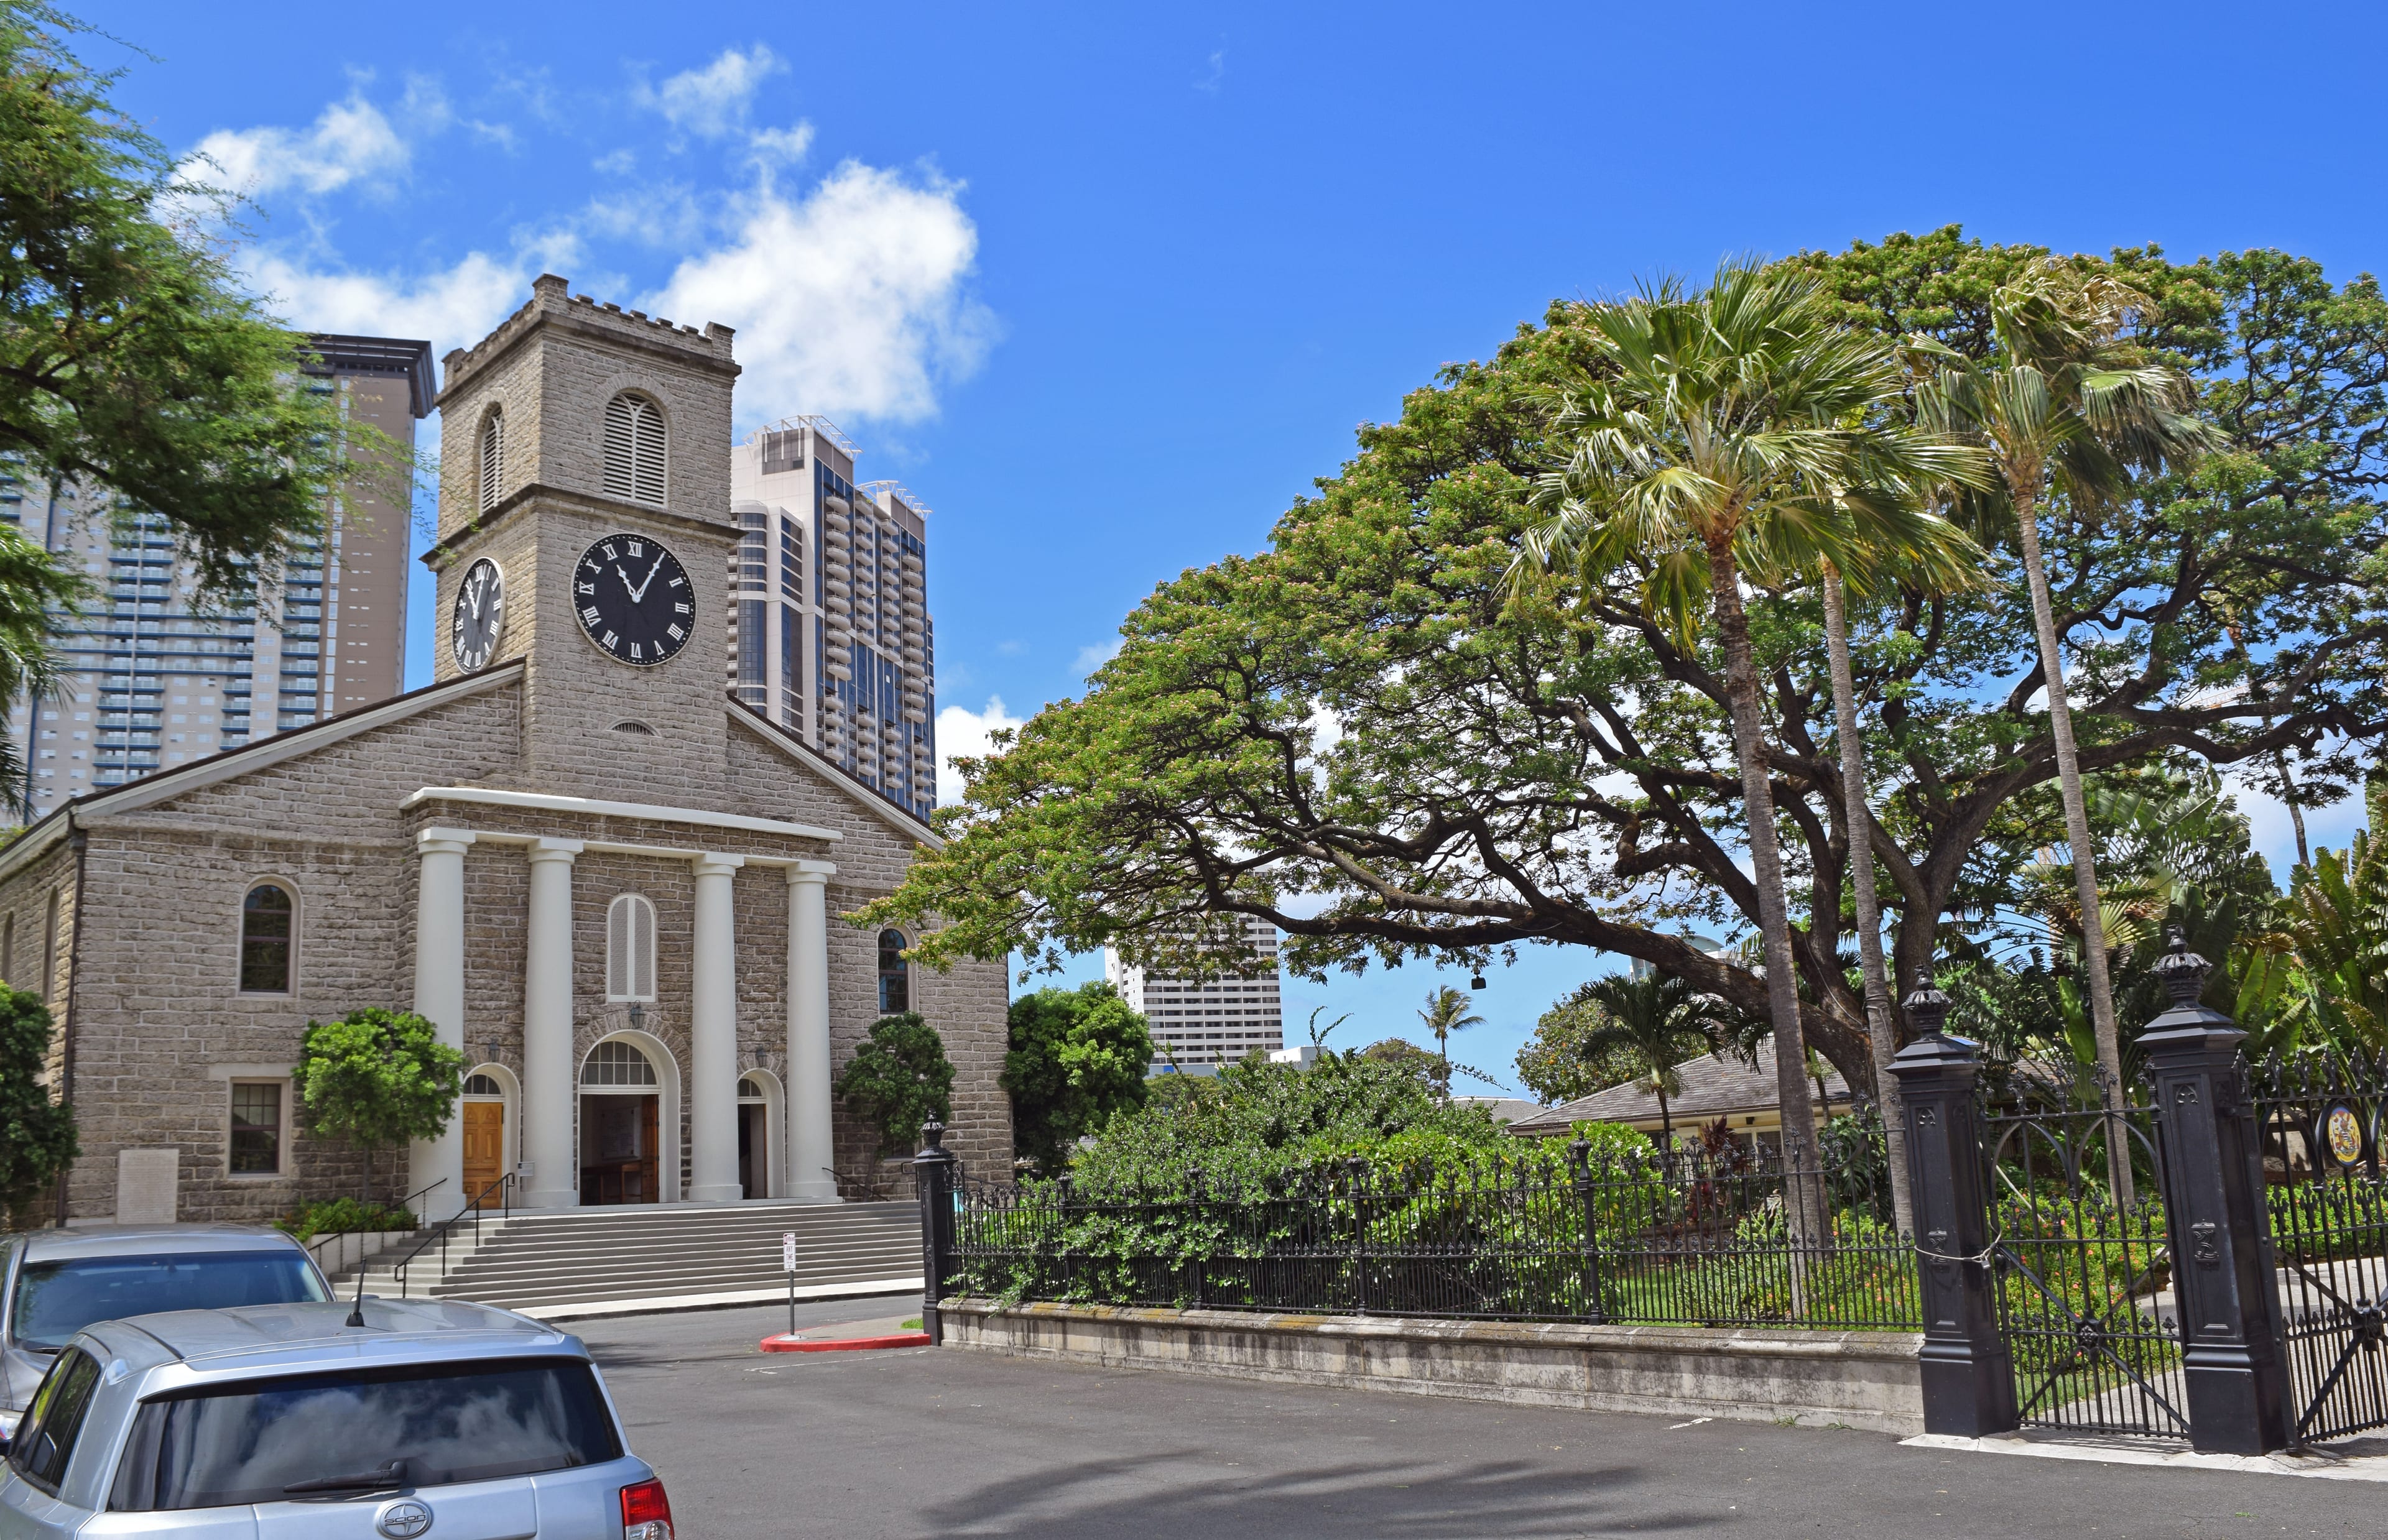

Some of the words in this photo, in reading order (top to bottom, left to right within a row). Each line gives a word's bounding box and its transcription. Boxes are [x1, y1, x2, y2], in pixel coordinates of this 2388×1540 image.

[601, 543, 618, 561] XI
[627, 541, 642, 558] XII
[585, 559, 602, 574] X
[579, 581, 595, 596] IX
[669, 577, 683, 588] II
[675, 602, 689, 614] III
[581, 606, 602, 627] VIII
[667, 622, 685, 641] IIII
[601, 629, 619, 650] VII
[631, 642, 642, 658] VI
[654, 640, 665, 655] V
[384, 1515, 426, 1523] SCION
